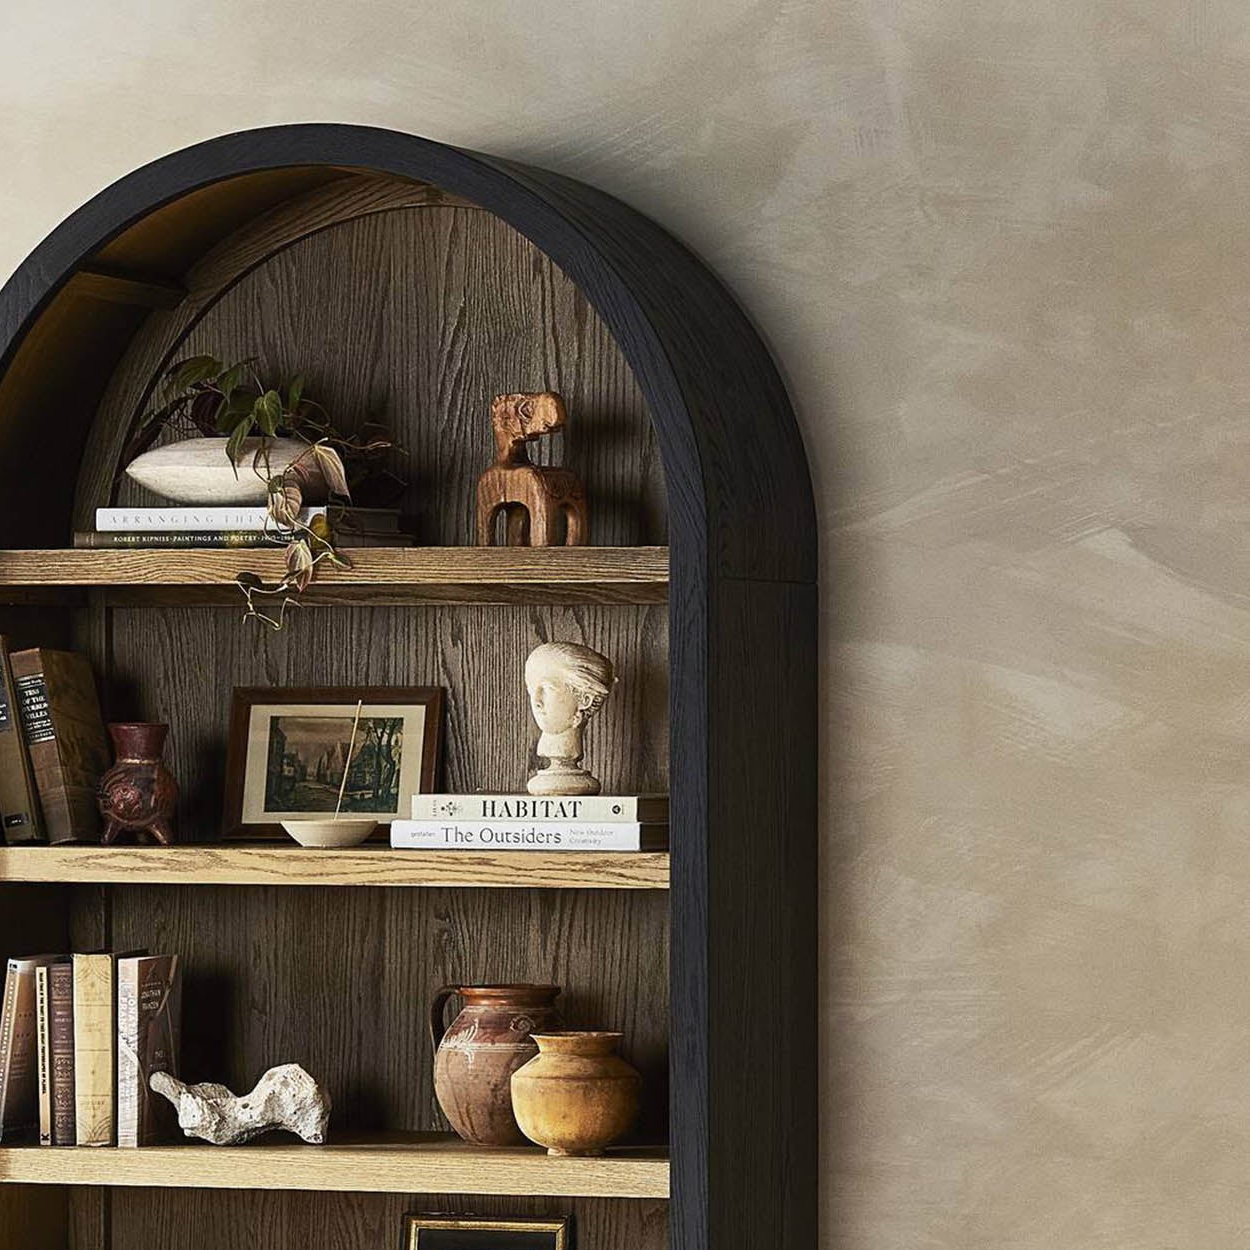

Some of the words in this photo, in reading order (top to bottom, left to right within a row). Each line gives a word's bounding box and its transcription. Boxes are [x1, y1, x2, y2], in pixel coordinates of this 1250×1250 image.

[110, 514, 215, 525] ARRANGING
[113, 535, 141, 543] ROBERT
[142, 535, 170, 543] KIPNISS
[481, 800, 582, 819] HABITAT
[441, 827, 474, 843] The
[479, 827, 562, 844] Outsiders
